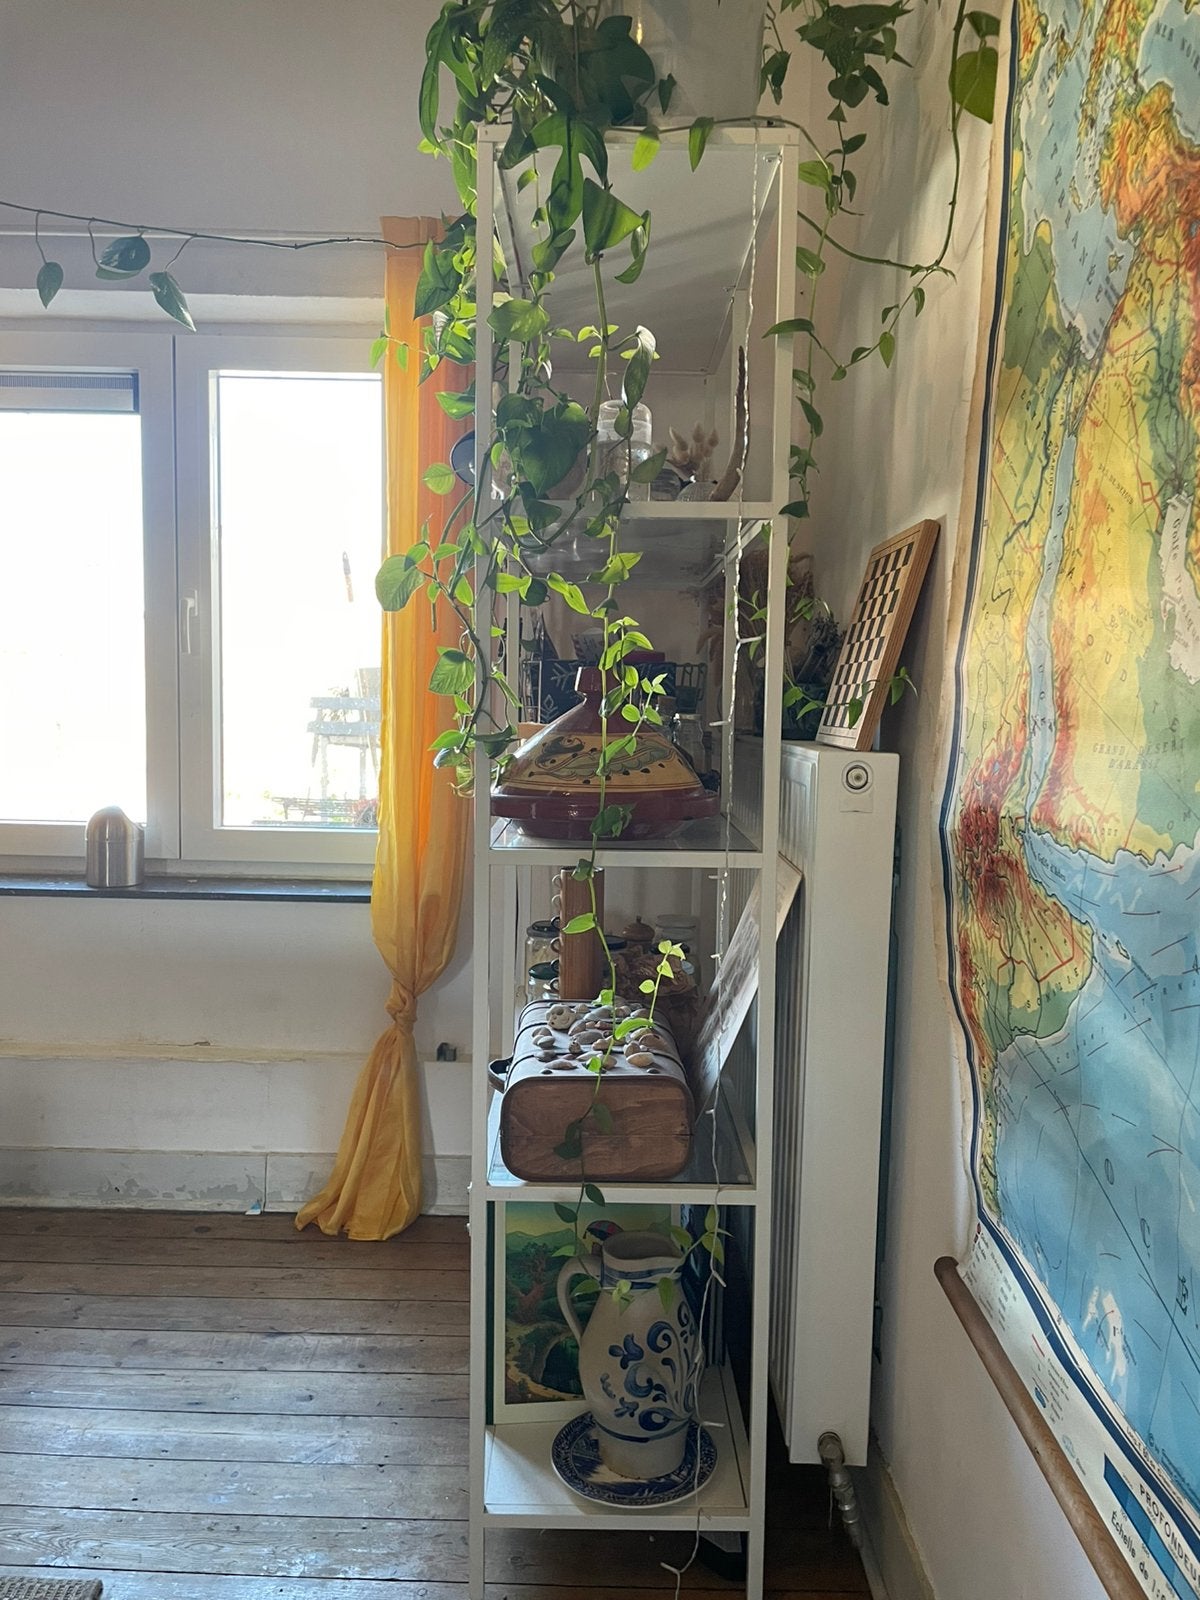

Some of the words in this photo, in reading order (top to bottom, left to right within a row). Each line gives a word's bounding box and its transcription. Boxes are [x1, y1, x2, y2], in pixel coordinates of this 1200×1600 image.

[1111, 1510, 1137, 1559] Échelle
[1138, 1560, 1149, 1580] de
[1138, 1483, 1200, 1589] PROFONDEU
